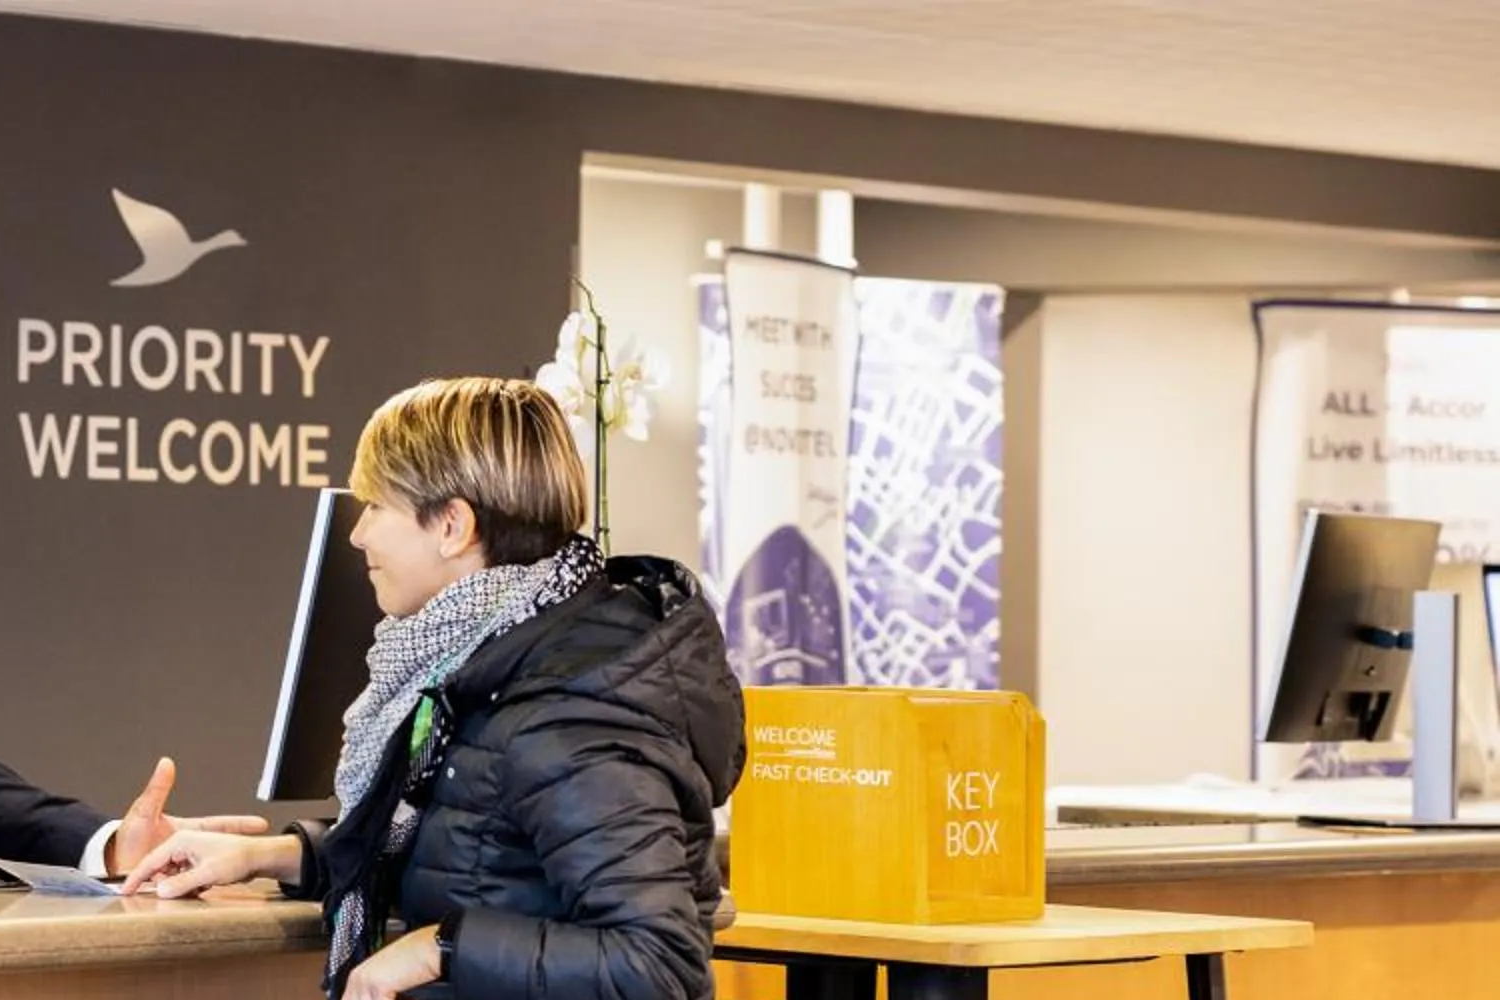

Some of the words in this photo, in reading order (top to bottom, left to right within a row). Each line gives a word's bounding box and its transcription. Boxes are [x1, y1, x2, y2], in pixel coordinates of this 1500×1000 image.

[17, 317, 330, 398] PRIORITY
[1322, 390, 1377, 417] ALL
[1407, 395, 1486, 420] Accor
[18, 411, 331, 488] WELCOME
[1307, 436, 1362, 461] Live
[1372, 438, 1500, 464] Limitless
[752, 726, 837, 747] WELCOME
[752, 763, 792, 781] FAST
[795, 765, 893, 787] CHECK-OUT
[946, 772, 1000, 811] KEY
[946, 820, 1000, 858] BOX
